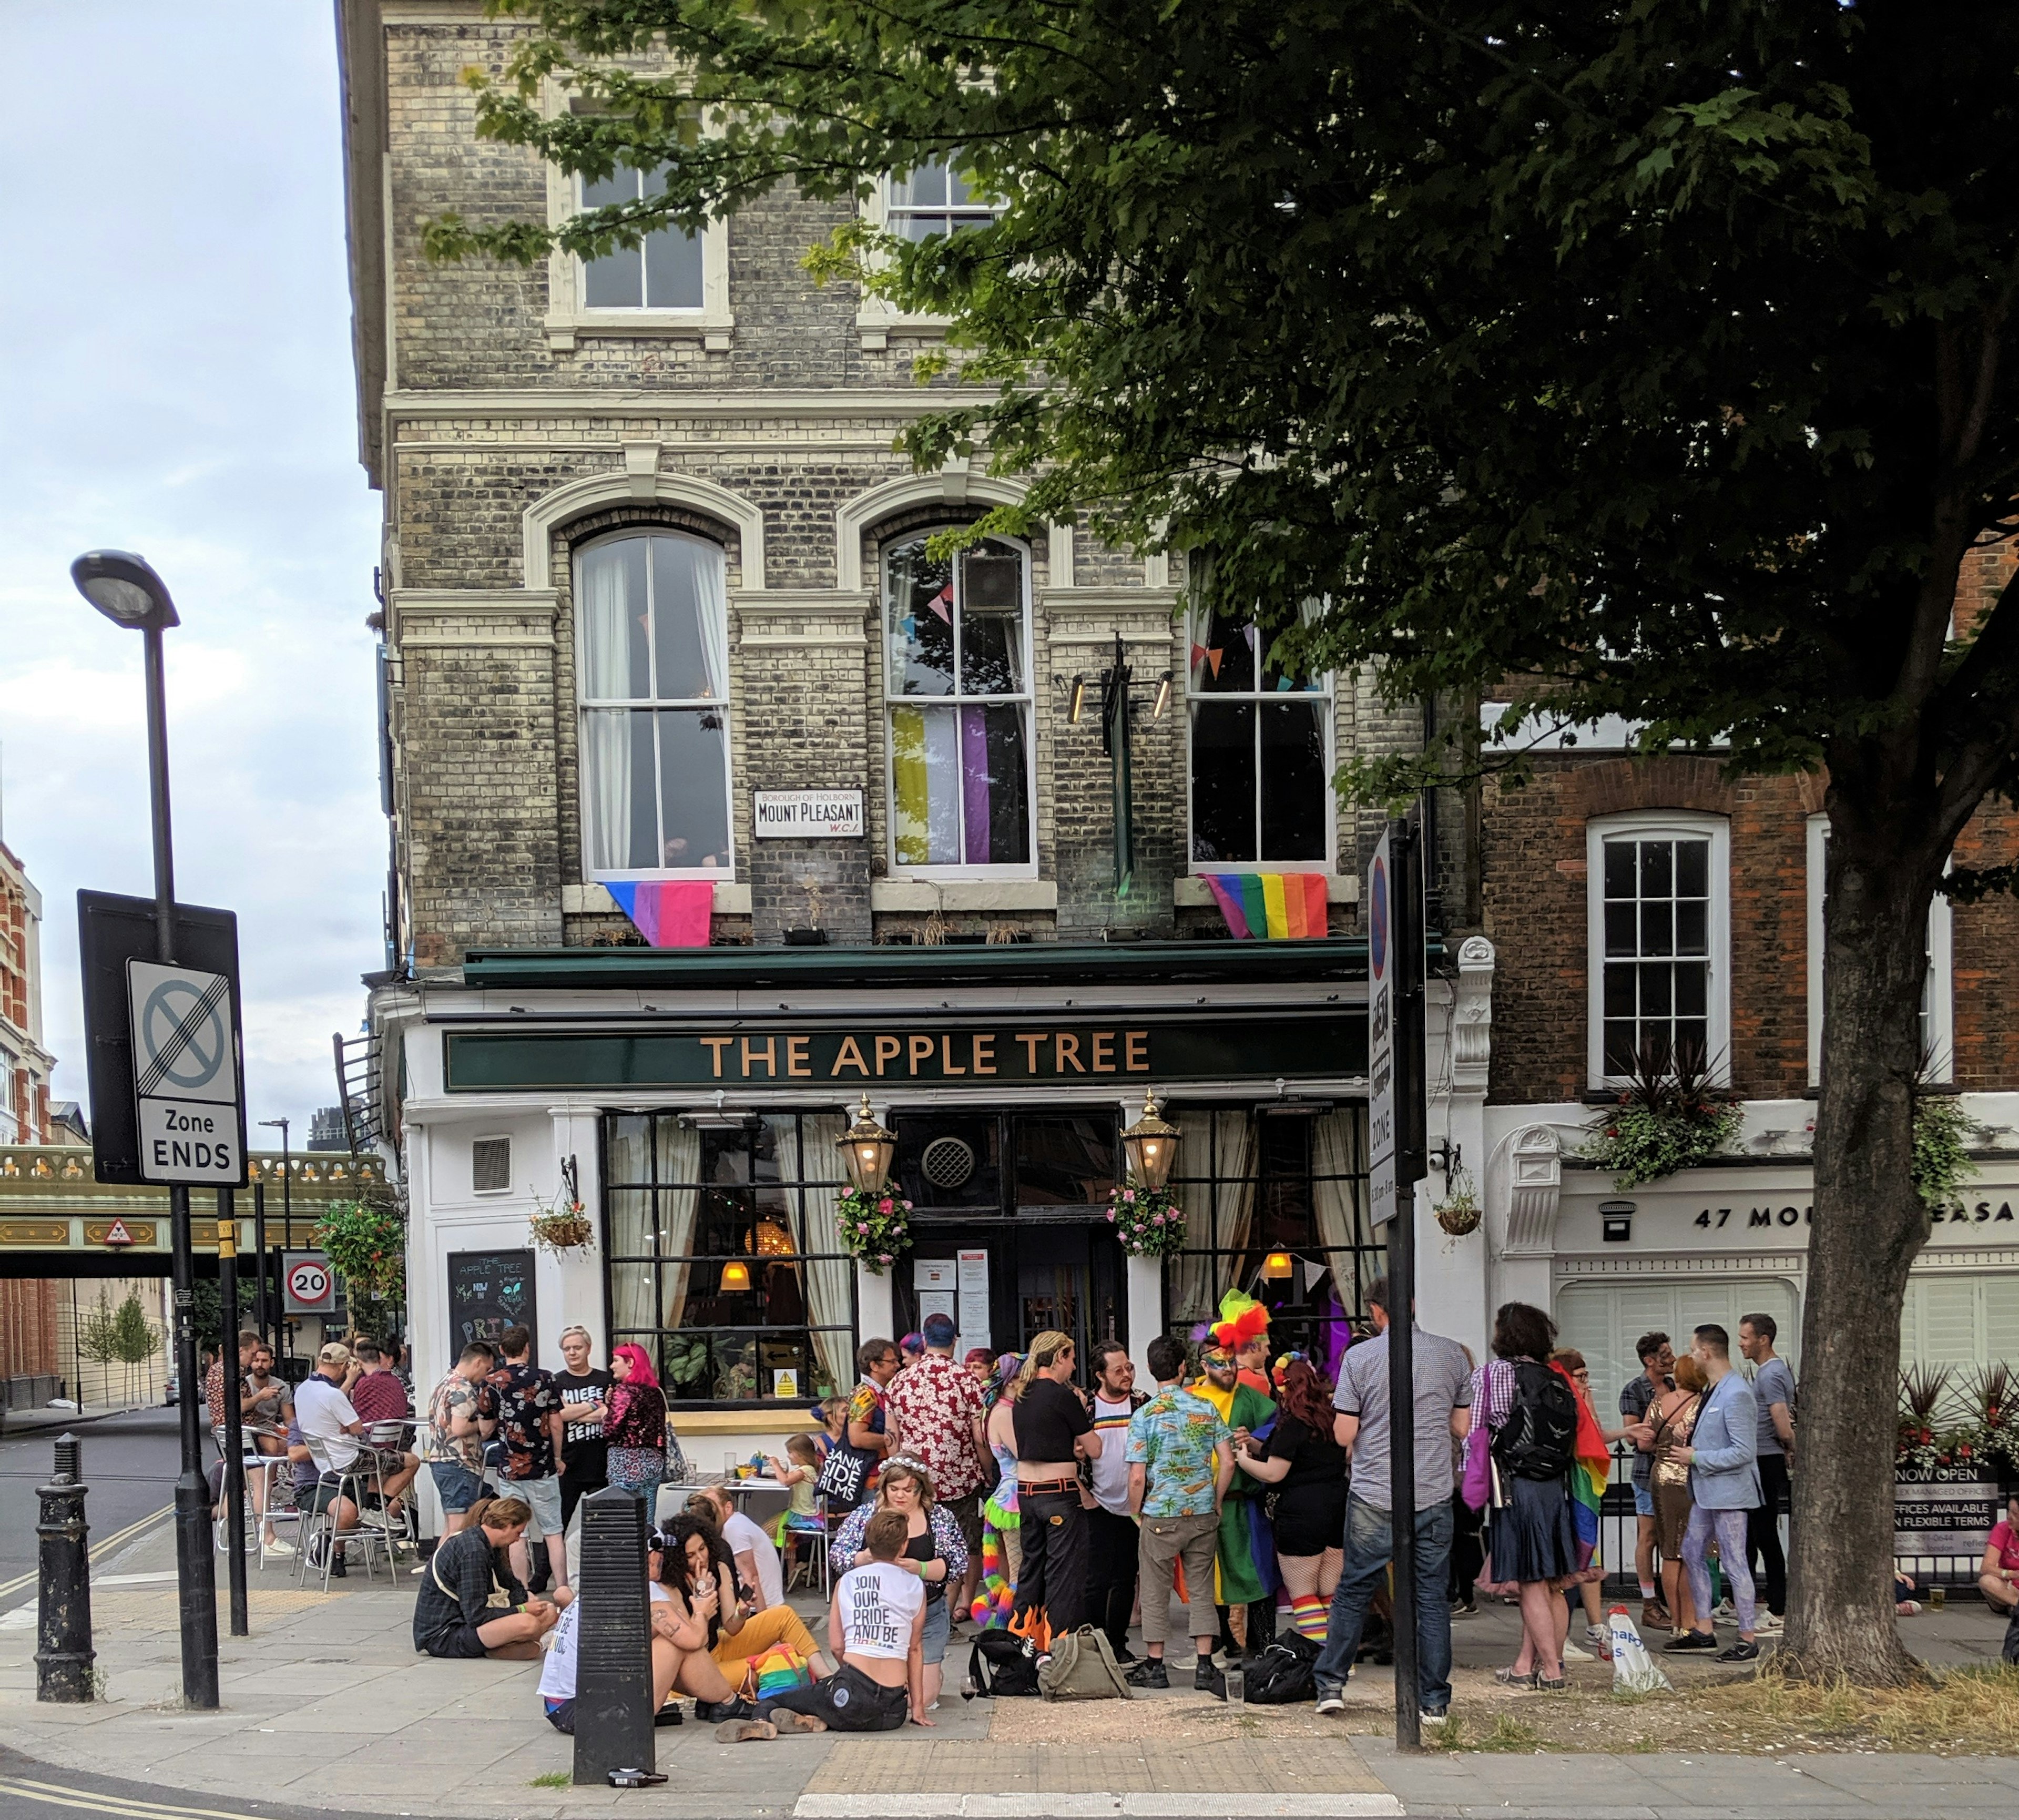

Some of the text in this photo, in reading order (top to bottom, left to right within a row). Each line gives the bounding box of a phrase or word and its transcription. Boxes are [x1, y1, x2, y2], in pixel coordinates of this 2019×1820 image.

[759, 802, 860, 822] MOUNT PLEASANT
[699, 1031, 1150, 1077] THE APPLE TREE
[165, 1109, 214, 1133] Zone
[1372, 1110, 1390, 1151] ZONE
[153, 1139, 230, 1170] ENDS
[1695, 1208, 1731, 1227] 47
[459, 1263, 522, 1275] APPLE TREE
[295, 1274, 325, 1291] 20
[462, 1317, 528, 1343] PRID
[562, 1385, 604, 1404] HIEEE
[825, 1448, 864, 1472] BANK
[823, 1459, 861, 1489] SIDE
[1894, 1468, 1979, 1481] NOW OPEN
[819, 1475, 856, 1501] FILMS
[1931, 1503, 1990, 1514] AVAILABLE
[1904, 1517, 1952, 1527] FLEXIBLE
[1953, 1516, 1990, 1526] TERMS
[854, 1575, 881, 1591] JOIN
[853, 1591, 880, 1608] OUR
[853, 1608, 890, 1626] PRIDE
[853, 1625, 899, 1643] AND BE
